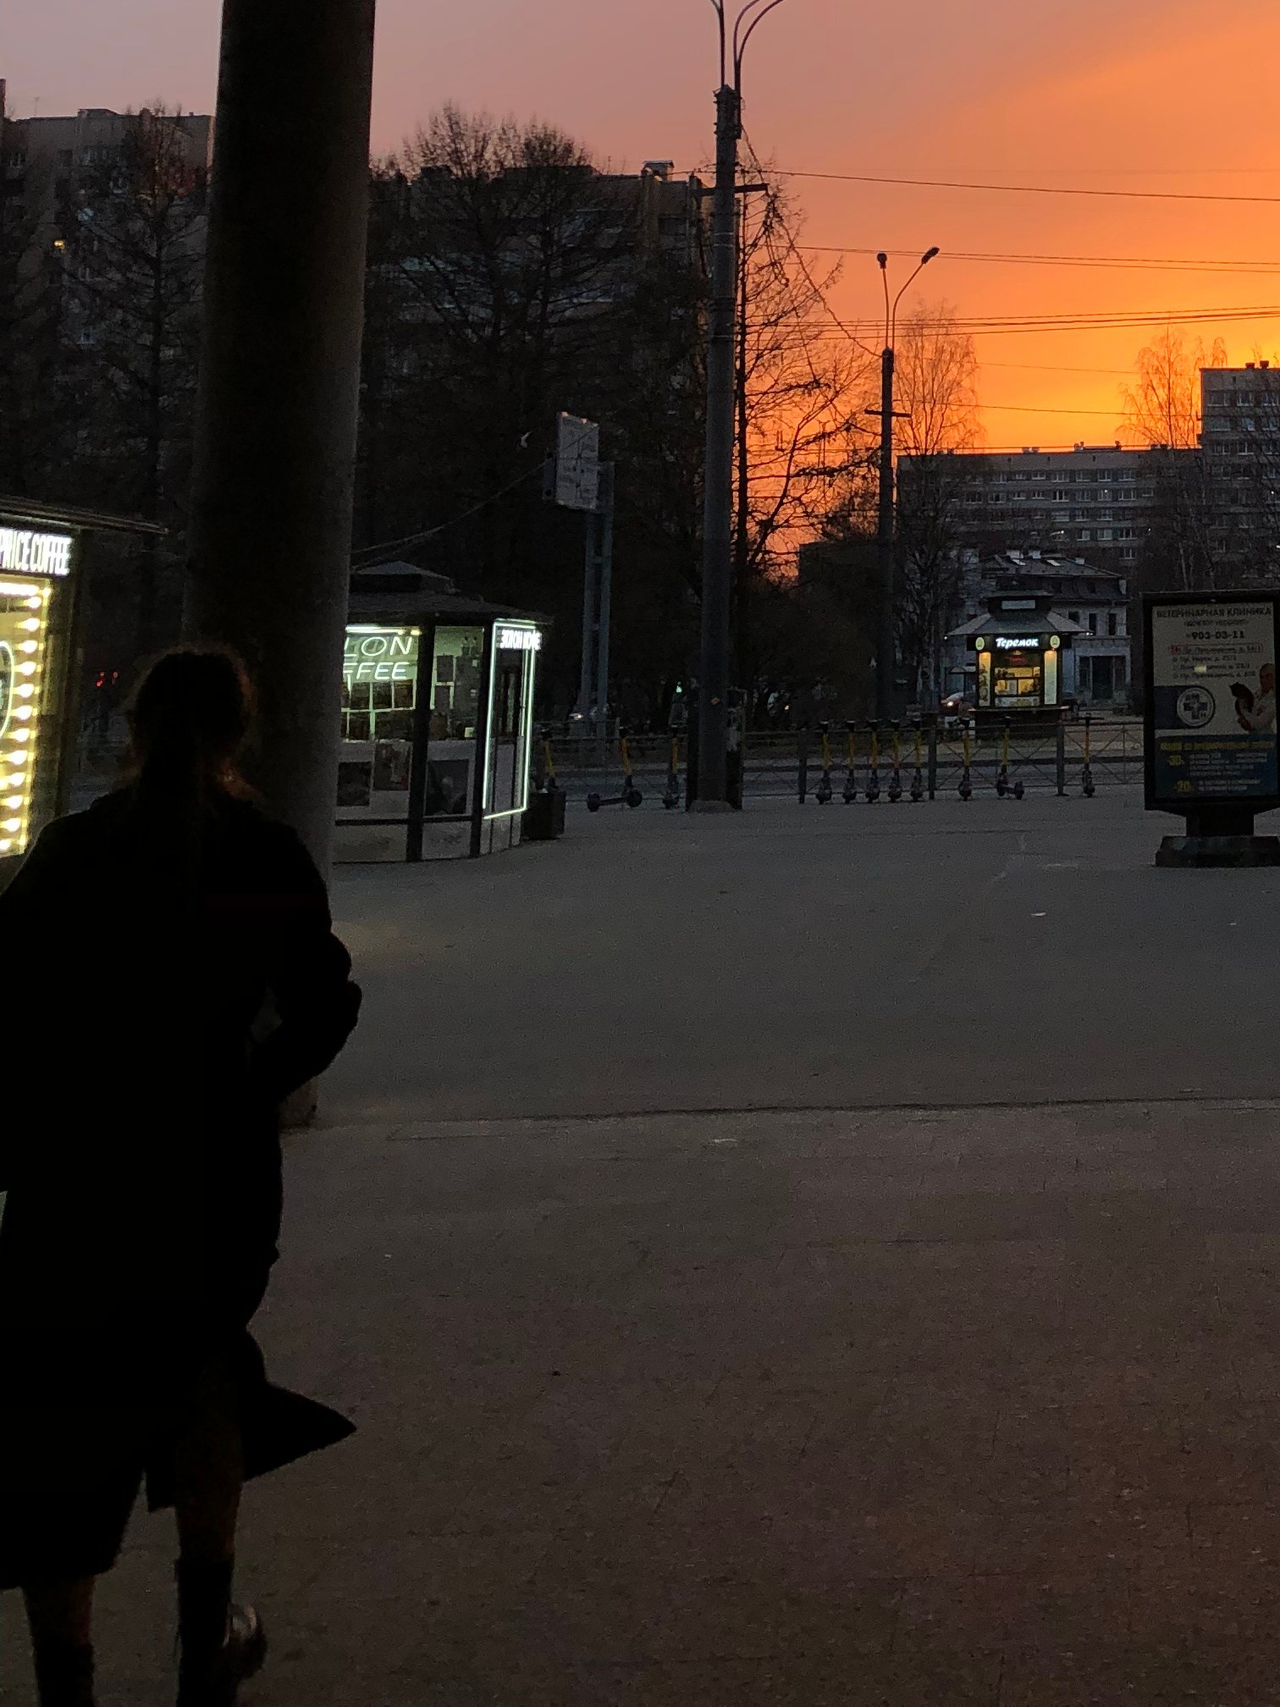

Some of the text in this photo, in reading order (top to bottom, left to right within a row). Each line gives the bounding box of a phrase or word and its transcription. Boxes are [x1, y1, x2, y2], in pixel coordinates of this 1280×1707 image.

[30, 534, 71, 575] COFFEE
[1156, 607, 1272, 618] ВЕТЕРИНАРНАЯ КЛИНИКА
[995, 636, 1040, 650] Теремок
